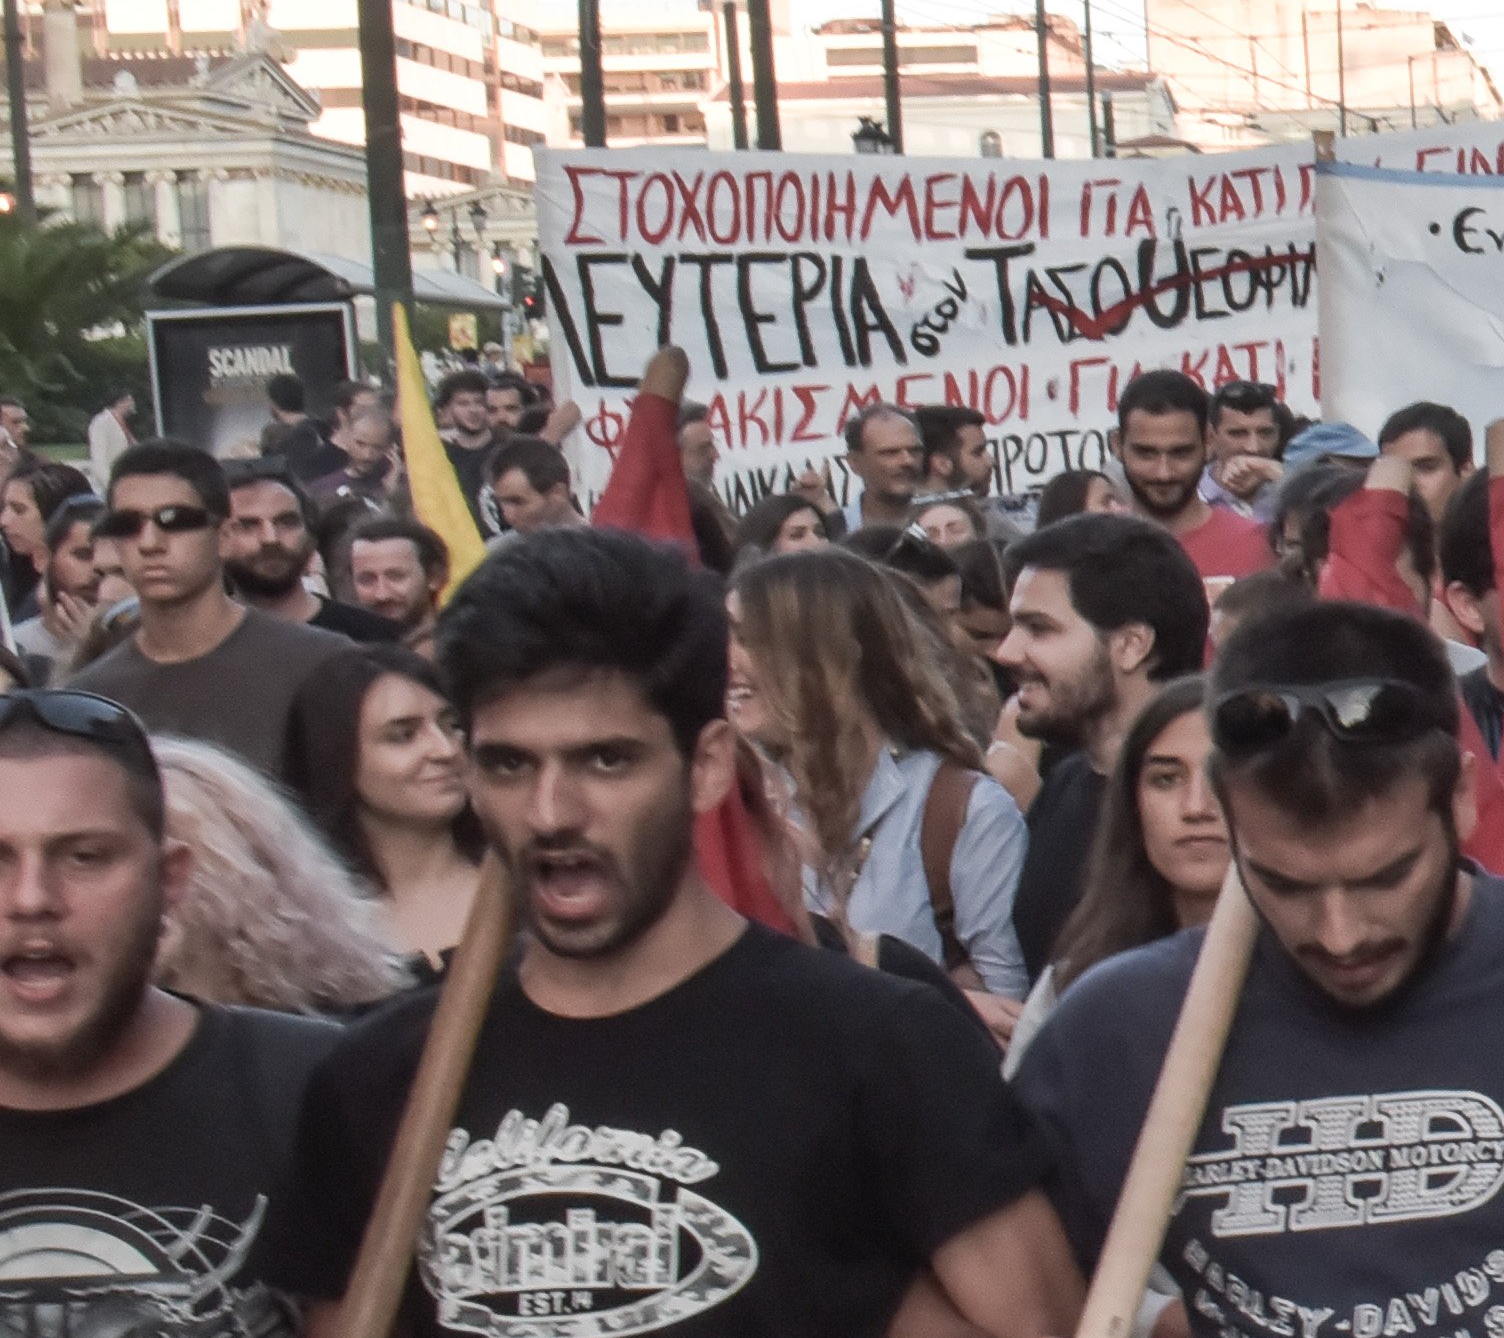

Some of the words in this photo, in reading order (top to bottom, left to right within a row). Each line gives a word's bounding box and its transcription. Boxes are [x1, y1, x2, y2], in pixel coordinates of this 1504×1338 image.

[564, 166, 1049, 246] ΣΤΟΧΟΠΟΙΗΜΕΝΟΙ
[208, 345, 296, 378] SCANDAL
[1186, 1147, 1388, 1186] ARLEY-DAVIDSON
